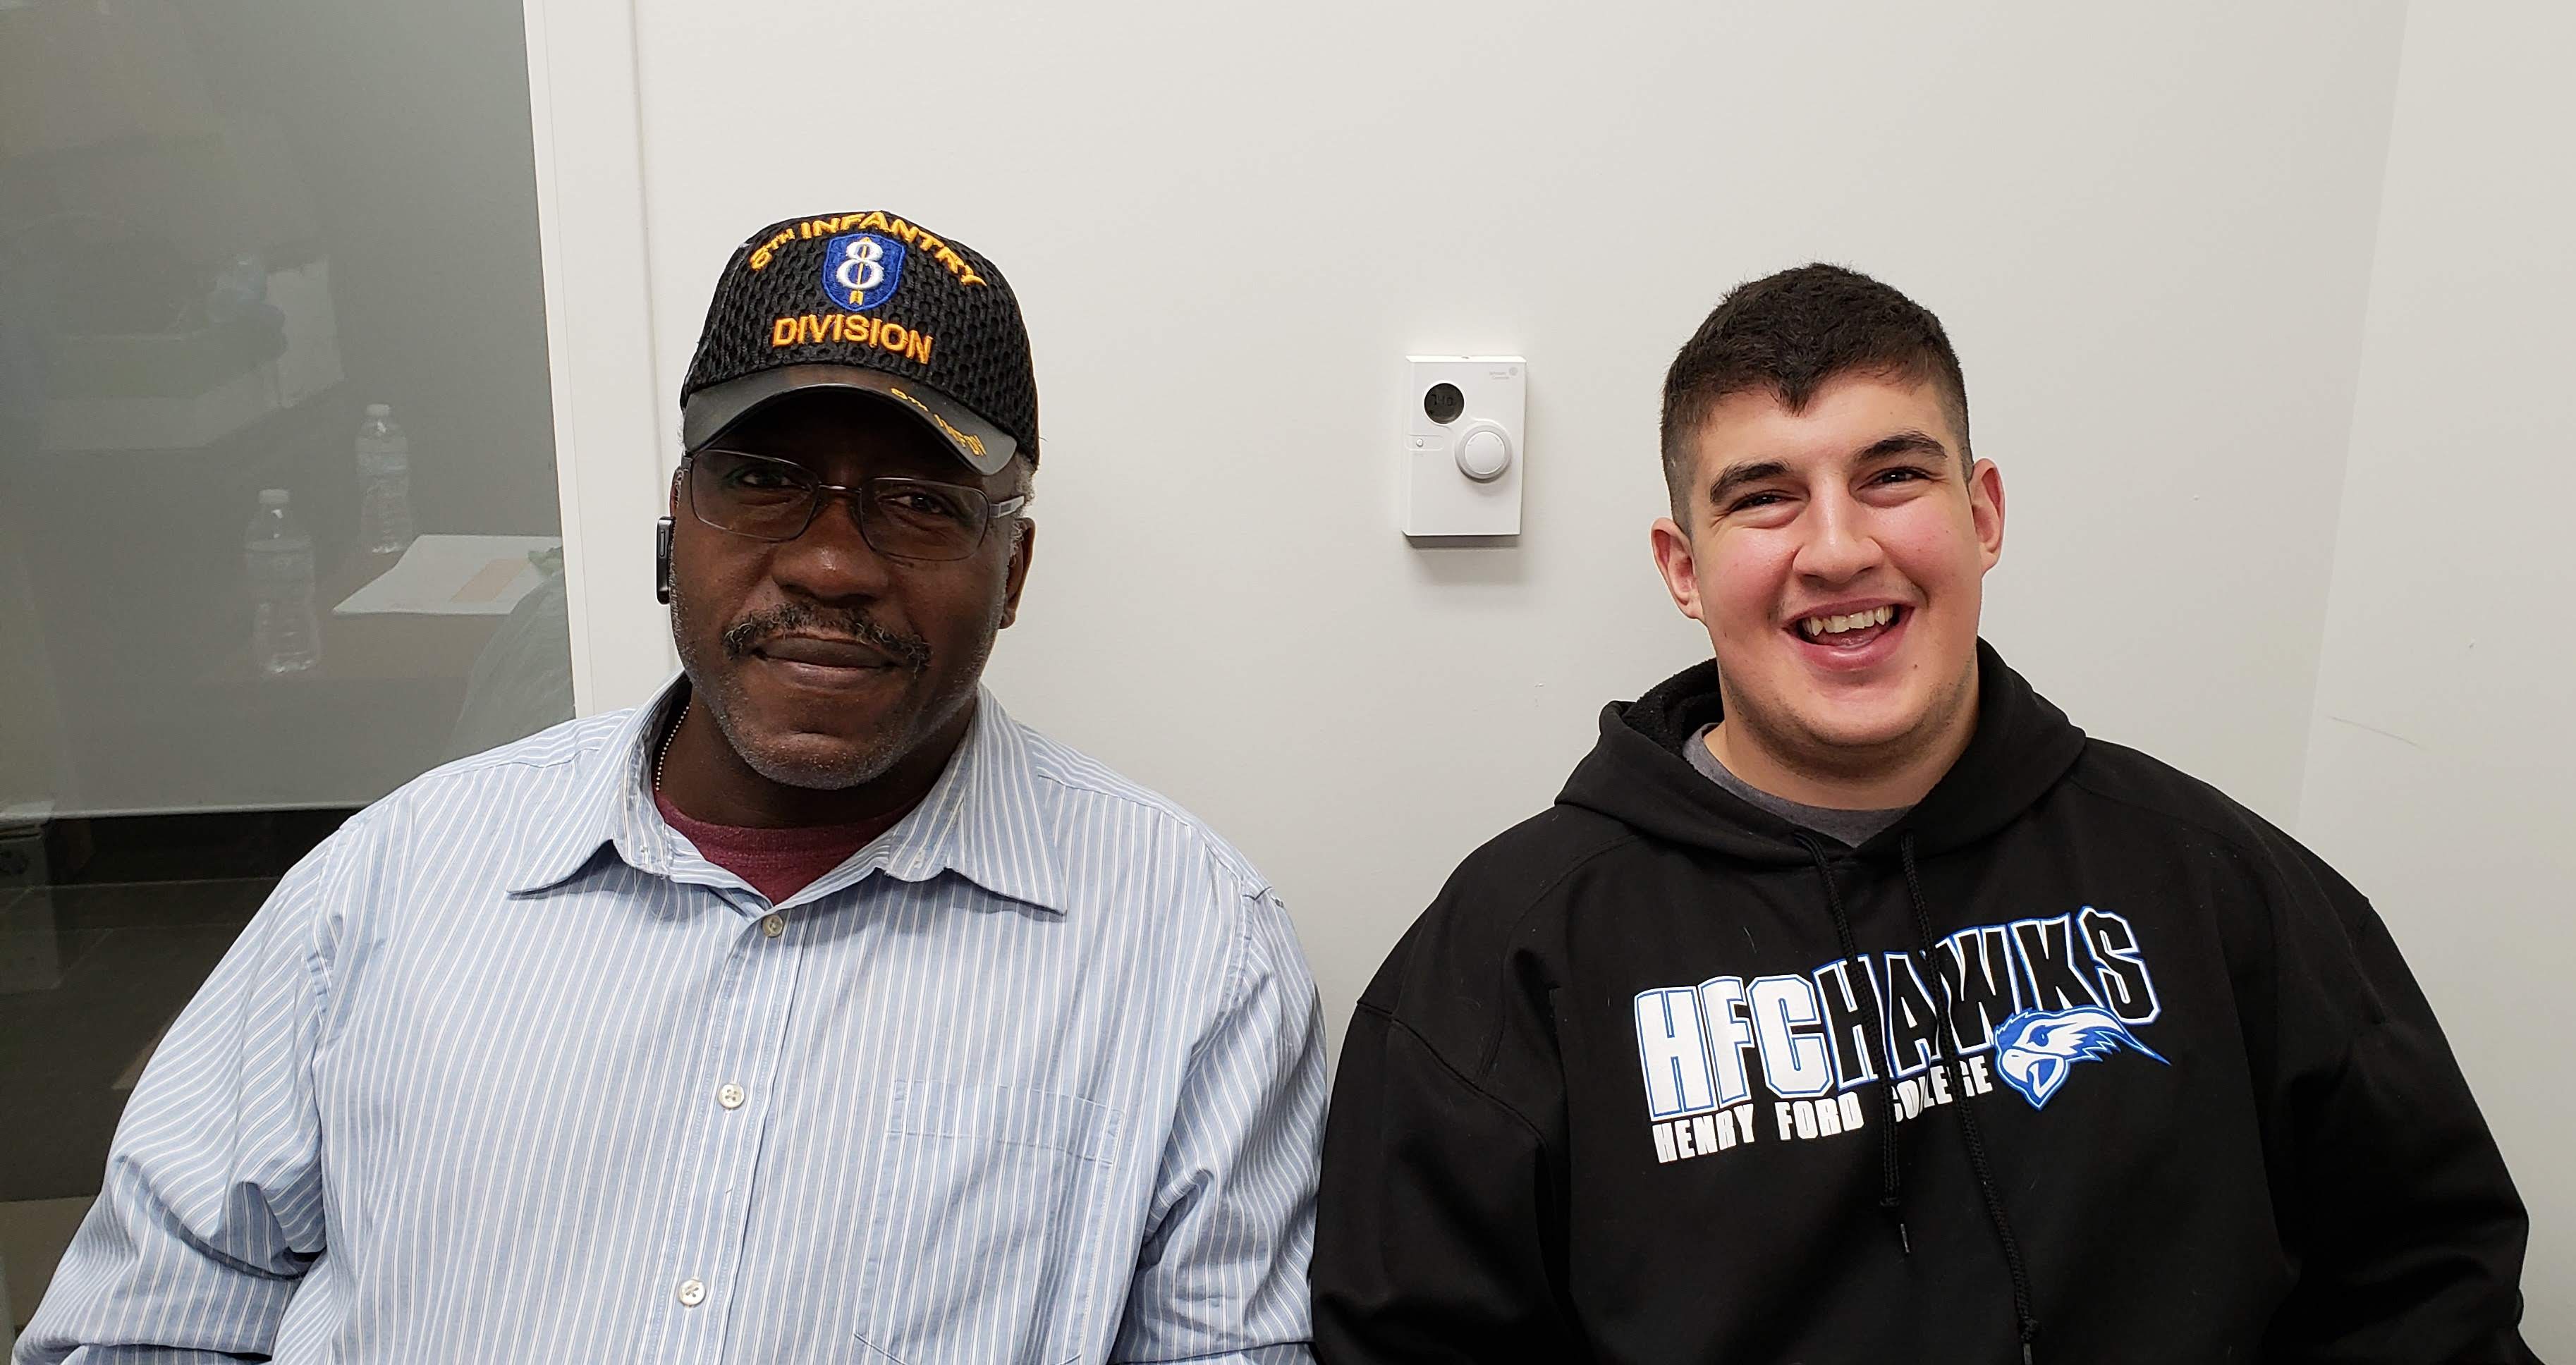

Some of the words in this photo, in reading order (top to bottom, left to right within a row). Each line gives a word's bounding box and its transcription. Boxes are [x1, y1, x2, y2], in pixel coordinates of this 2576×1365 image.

[801, 211, 987, 287] INFANTRY
[836, 240, 885, 290] 8
[773, 314, 934, 365] DIVISION
[1652, 1103, 1754, 1164] HENRY
[1776, 1092, 1864, 1141] FORD
